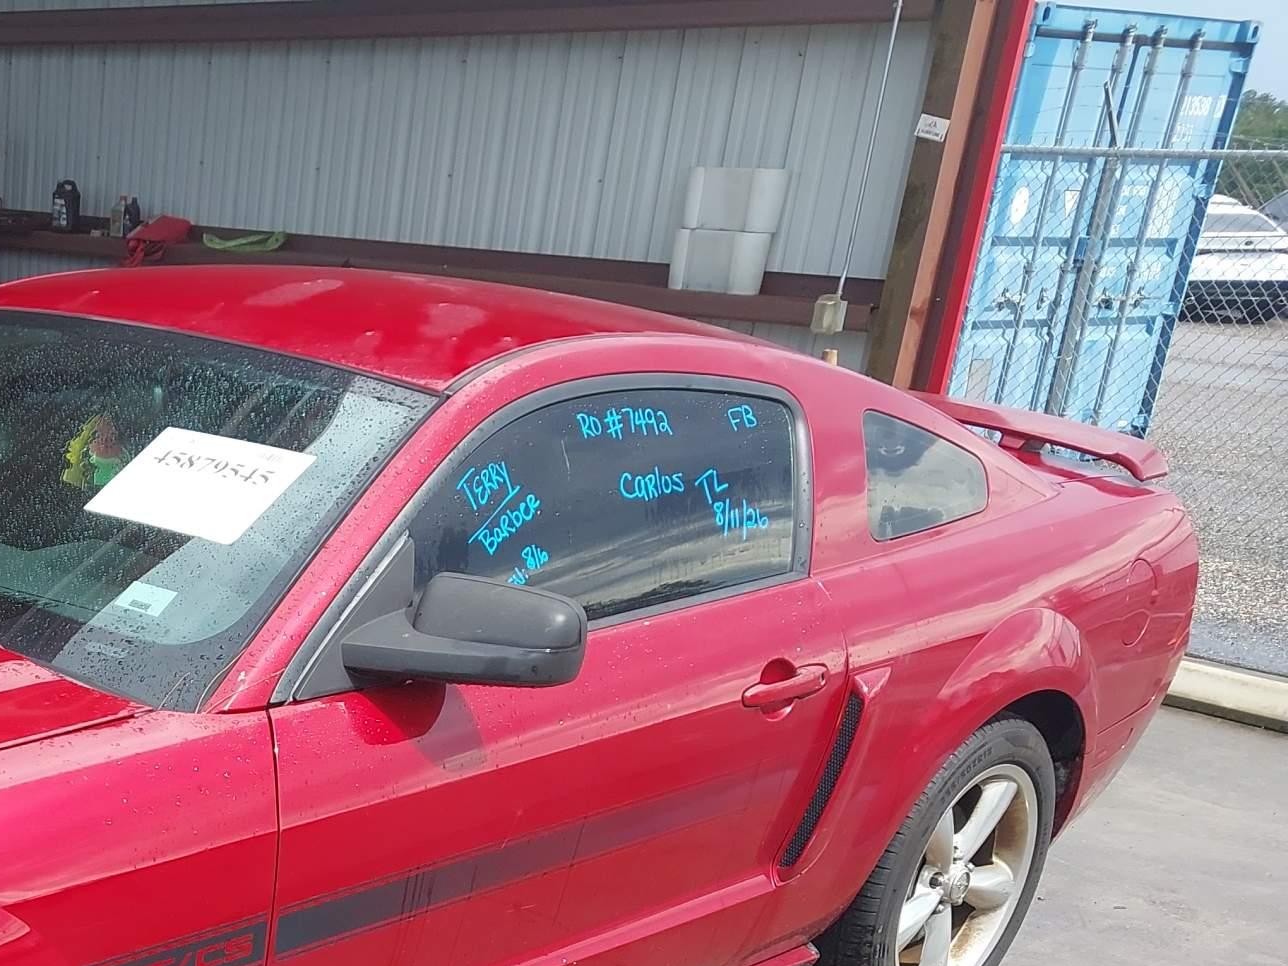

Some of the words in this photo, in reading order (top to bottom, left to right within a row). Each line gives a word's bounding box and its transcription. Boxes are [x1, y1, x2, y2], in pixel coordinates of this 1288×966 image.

[727, 405, 758, 432] FB
[154, 450, 275, 484] 45879545
[713, 498, 769, 540] 8/11/26
